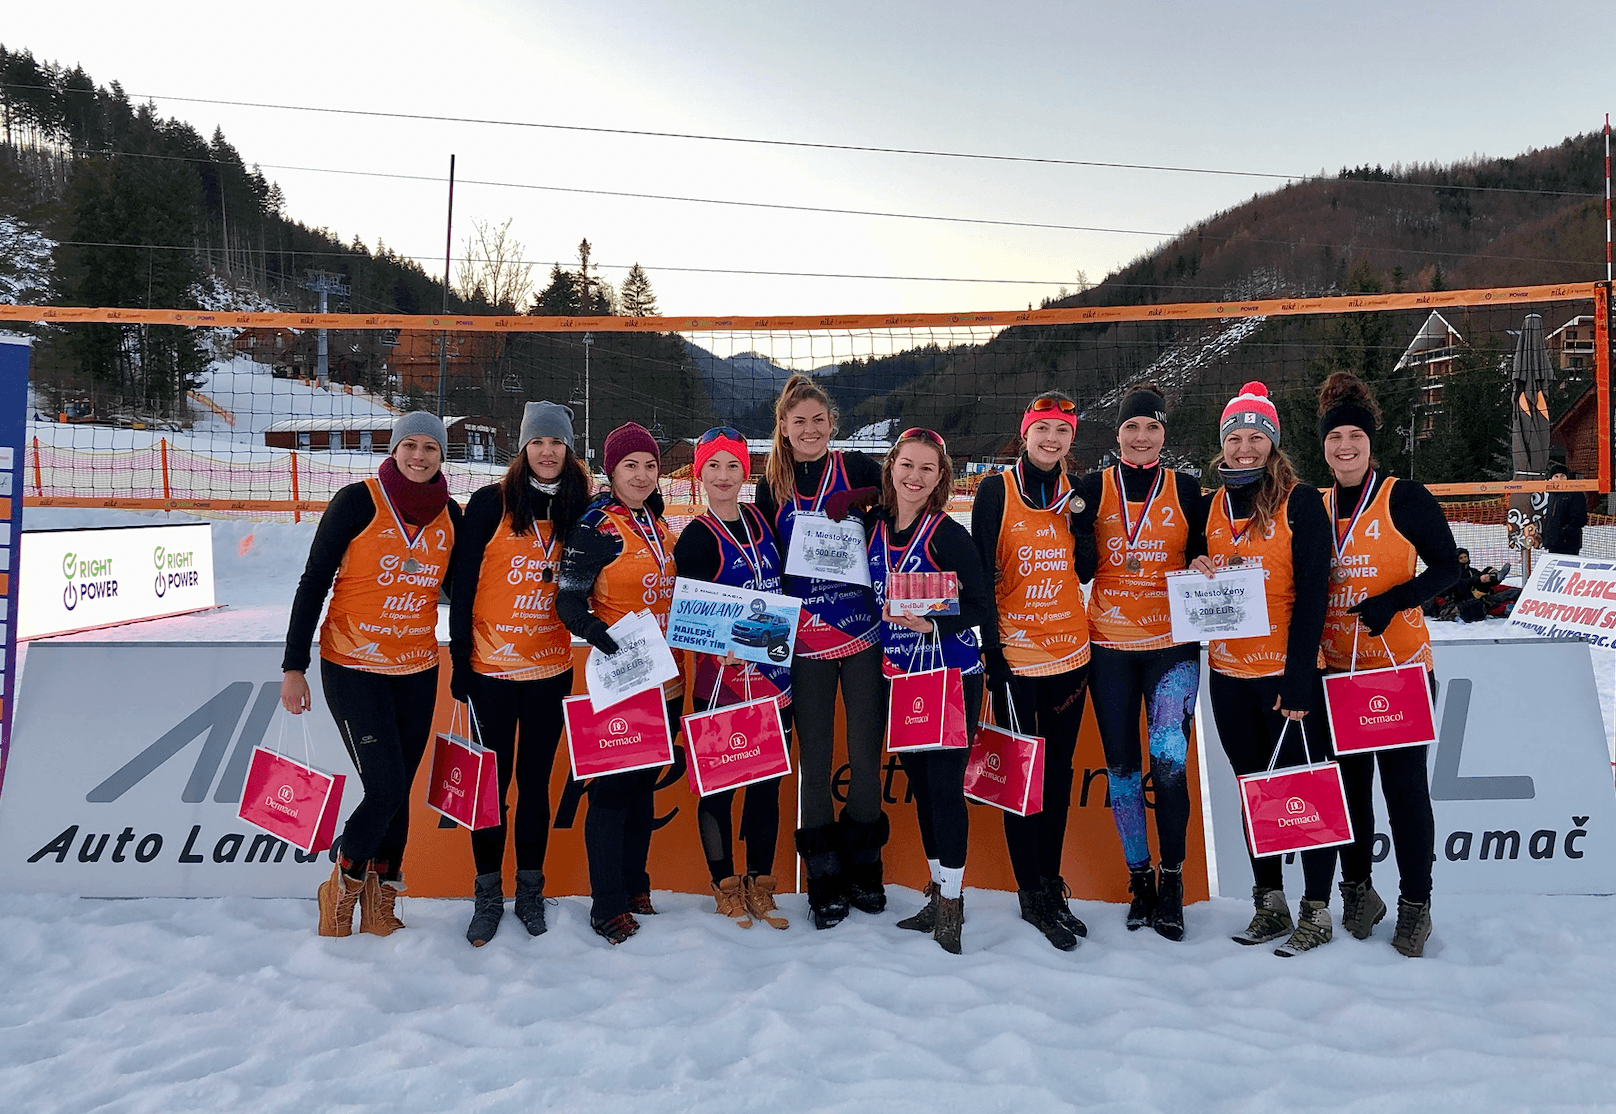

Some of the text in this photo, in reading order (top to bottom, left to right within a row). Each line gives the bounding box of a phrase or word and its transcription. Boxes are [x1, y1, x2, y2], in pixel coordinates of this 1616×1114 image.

[1161, 506, 1175, 527] 2
[1036, 529, 1050, 538] SVF
[1264, 518, 1276, 540] 3
[1364, 519, 1381, 540] 4
[435, 529, 448, 551] 2
[167, 551, 194, 569] RIGHT
[815, 548, 848, 559] 500 EUR
[1034, 548, 1067, 560] RIGHT
[1126, 551, 1168, 562] POWER
[80, 558, 113, 578] RIGHT
[401, 561, 440, 576] GHT
[909, 555, 922, 573] 2
[168, 570, 199, 589] POWER
[397, 573, 439, 588] POWER
[525, 573, 560, 584] POE
[80, 580, 118, 601] POWER
[1103, 589, 1129, 597] NFA
[1184, 590, 1193, 599] 3.
[1194, 589, 1221, 598] Miesto
[512, 589, 554, 611] niké
[800, 596, 825, 606] NFA
[900, 602, 912, 610] Red
[676, 599, 744, 619] SNOWLAND
[1007, 610, 1071, 621] NFA GROUP
[1199, 606, 1235, 616] 200 EUR
[1517, 599, 1608, 626] SPORTOVNÍ
[359, 622, 392, 636] NFA
[496, 623, 524, 634] NFA
[673, 624, 715, 639] NAJLEPŠÍ
[672, 634, 726, 650] ŽENSKÝ TÍM
[884, 646, 901, 655] NFA
[610, 658, 644, 678] 300 EUR
[904, 713, 930, 726] Dermacol
[1358, 710, 1404, 726] Dermacol
[598, 732, 642, 749] Dermacol
[721, 746, 761, 765] Dermacol
[976, 766, 1007, 785] Dermacol
[442, 780, 466, 798] Dermacol
[265, 795, 299, 819] Dermacol
[1277, 812, 1320, 828] Dermacol
[26, 824, 164, 864] Auto
[1434, 816, 1590, 862] amač
